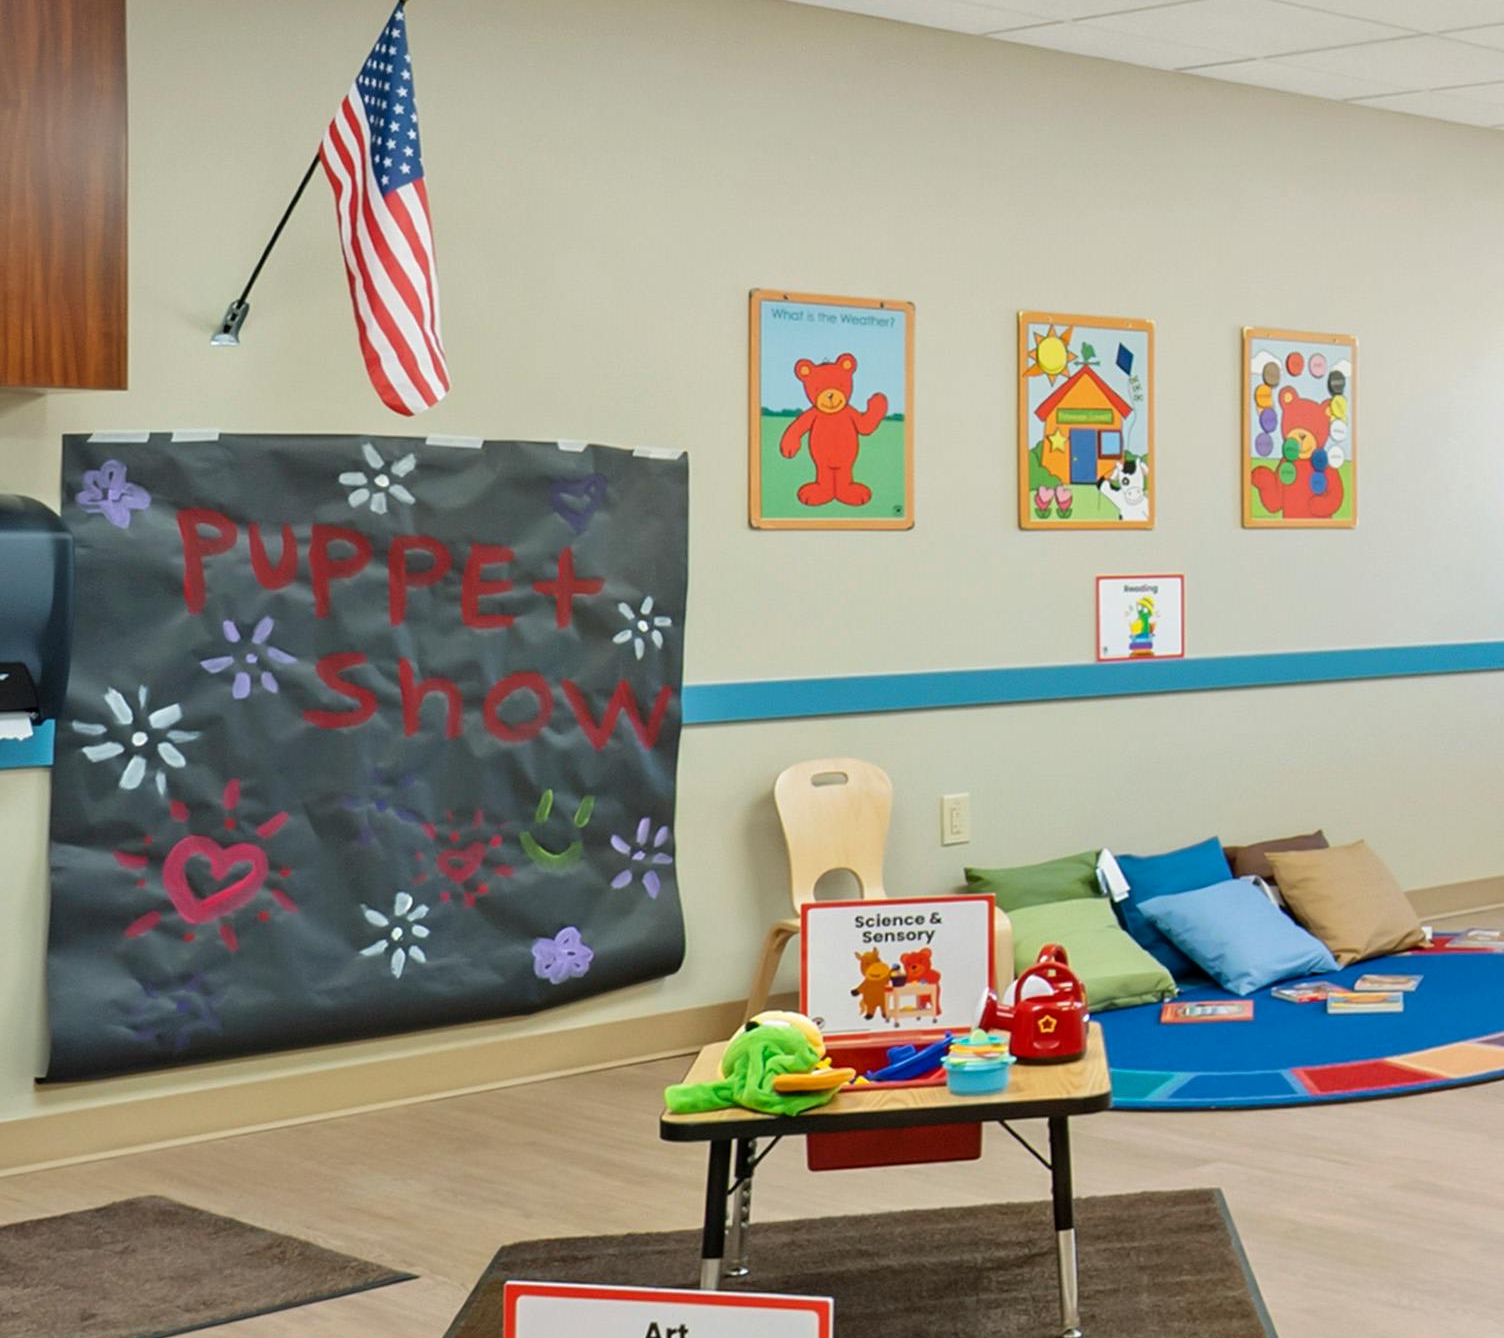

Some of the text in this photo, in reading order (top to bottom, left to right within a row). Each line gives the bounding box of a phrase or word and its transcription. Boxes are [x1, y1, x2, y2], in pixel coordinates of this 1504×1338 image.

[771, 308, 895, 328] What is the Weather?
[1123, 584, 1159, 595] Reading
[855, 911, 942, 928] Science &
[862, 929, 936, 945] Sensory
